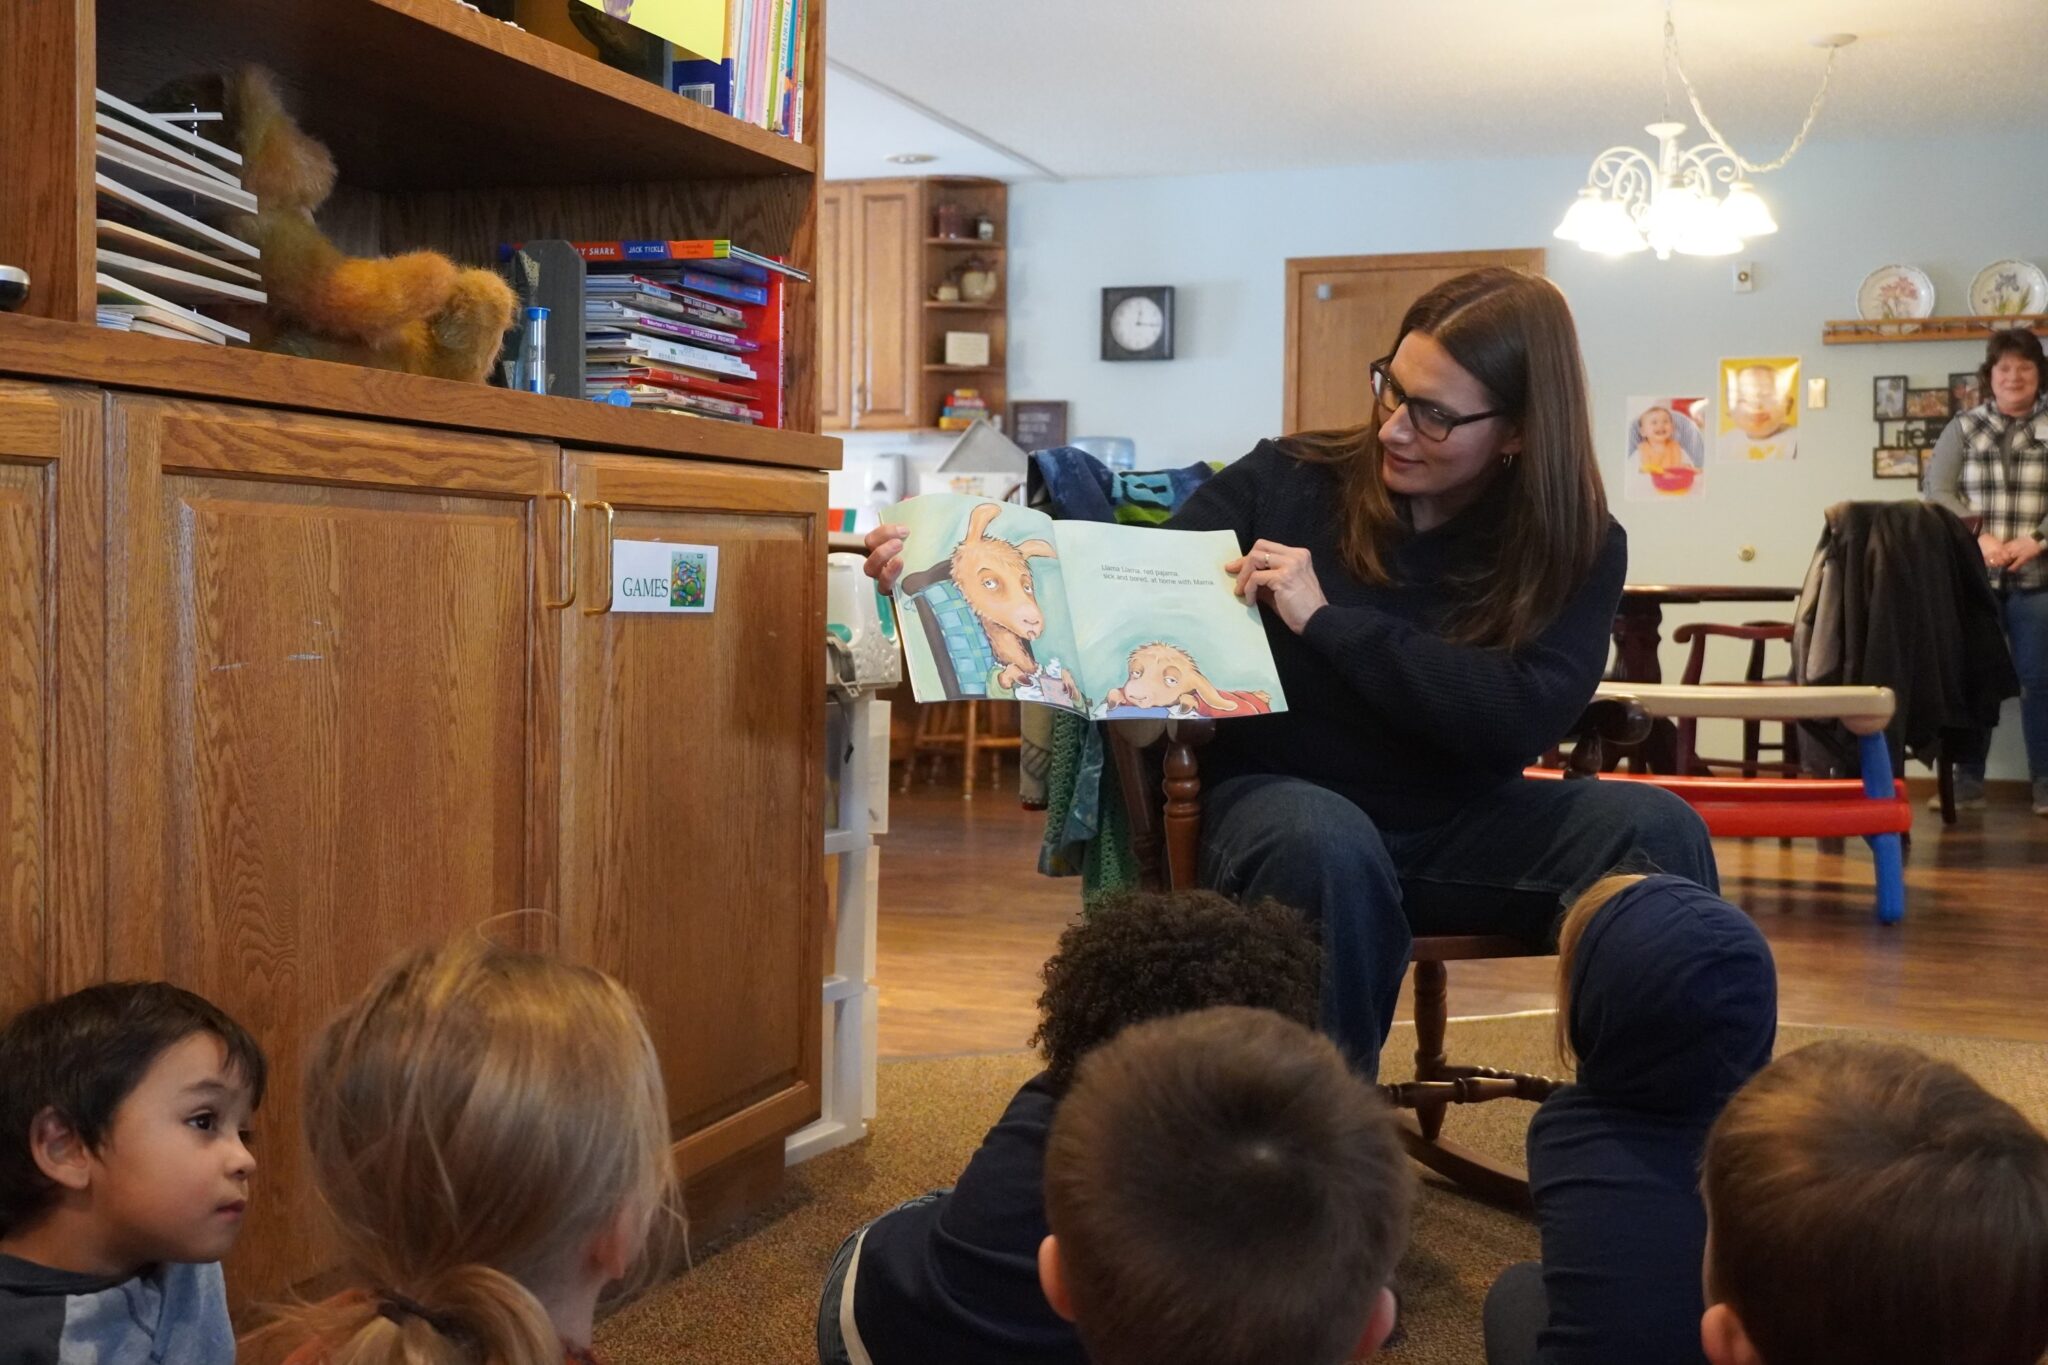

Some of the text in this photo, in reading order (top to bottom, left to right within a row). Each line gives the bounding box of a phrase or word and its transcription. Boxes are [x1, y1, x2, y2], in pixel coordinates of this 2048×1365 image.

[589, 247, 615, 256] SHARK
[644, 245, 664, 253] TICKLE
[1101, 564, 1120, 572] Llama
[1159, 577, 1176, 585] home
[1178, 578, 1191, 586] with
[622, 577, 669, 598] GAMES
